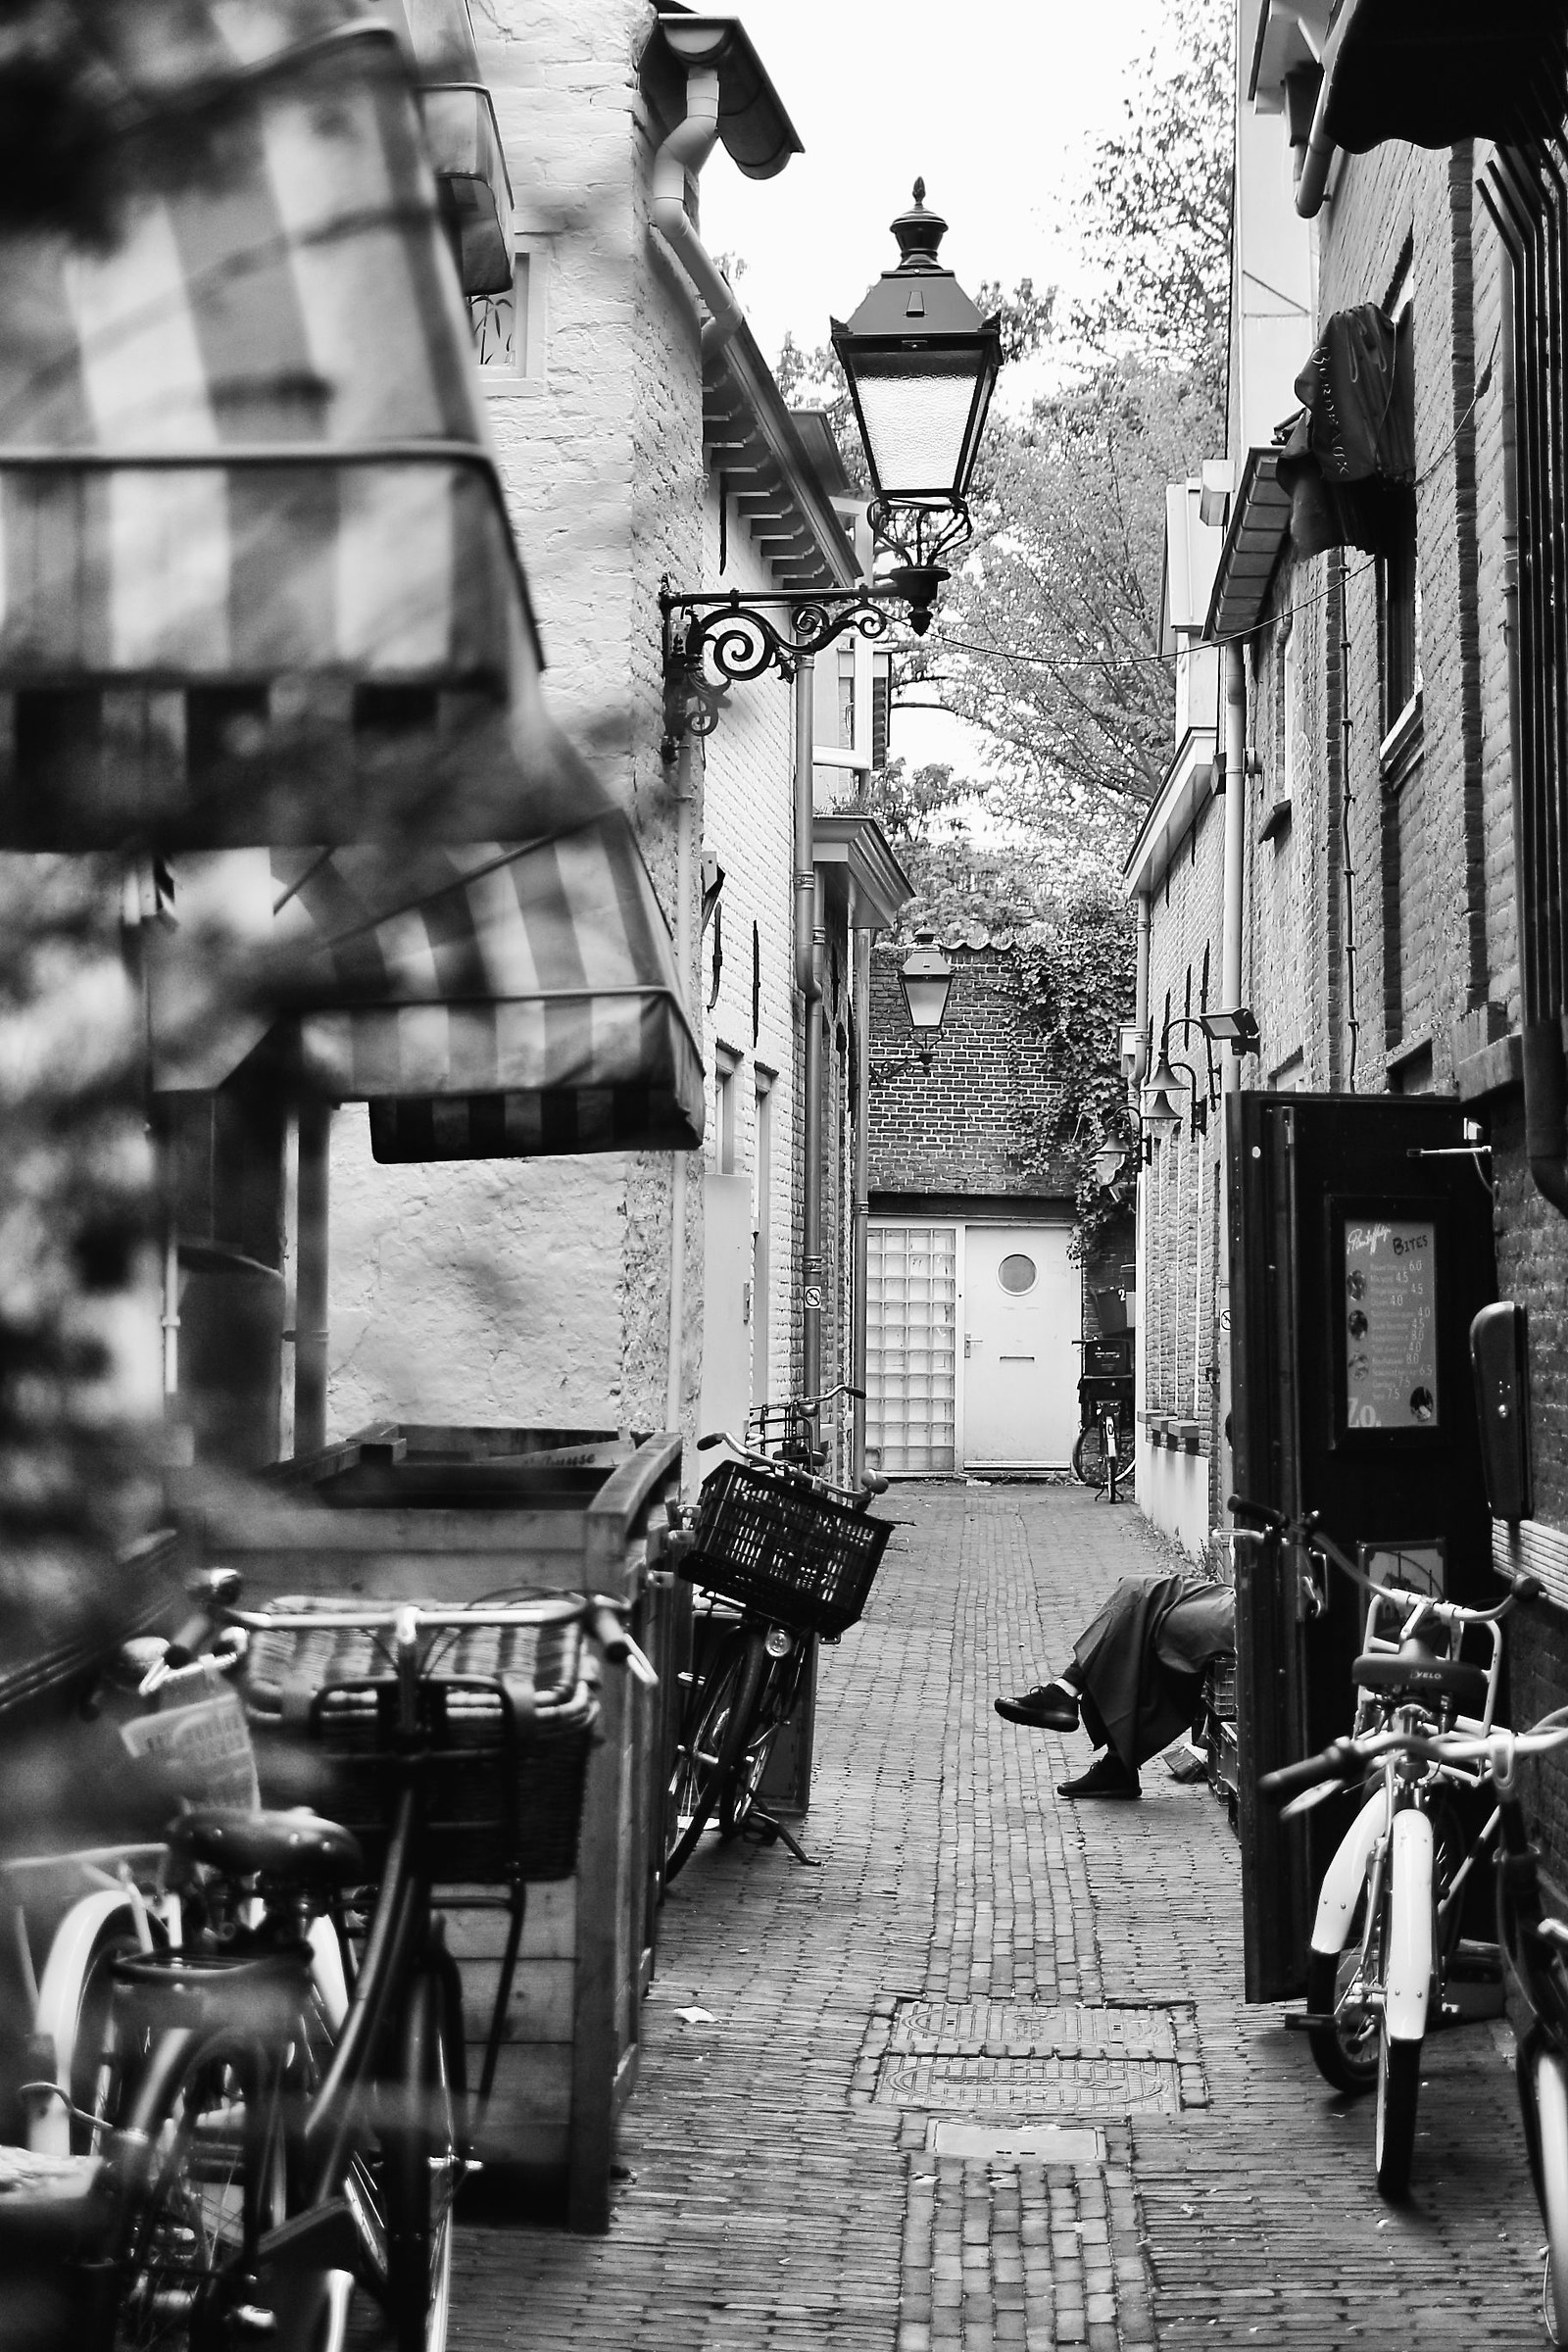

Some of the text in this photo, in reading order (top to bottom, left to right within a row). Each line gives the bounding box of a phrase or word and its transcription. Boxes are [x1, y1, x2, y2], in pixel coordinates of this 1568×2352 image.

[1393, 1235, 1428, 1255] BITES
[1118, 1289, 1126, 1301] 2
[1415, 1671, 1443, 1680] VELO
